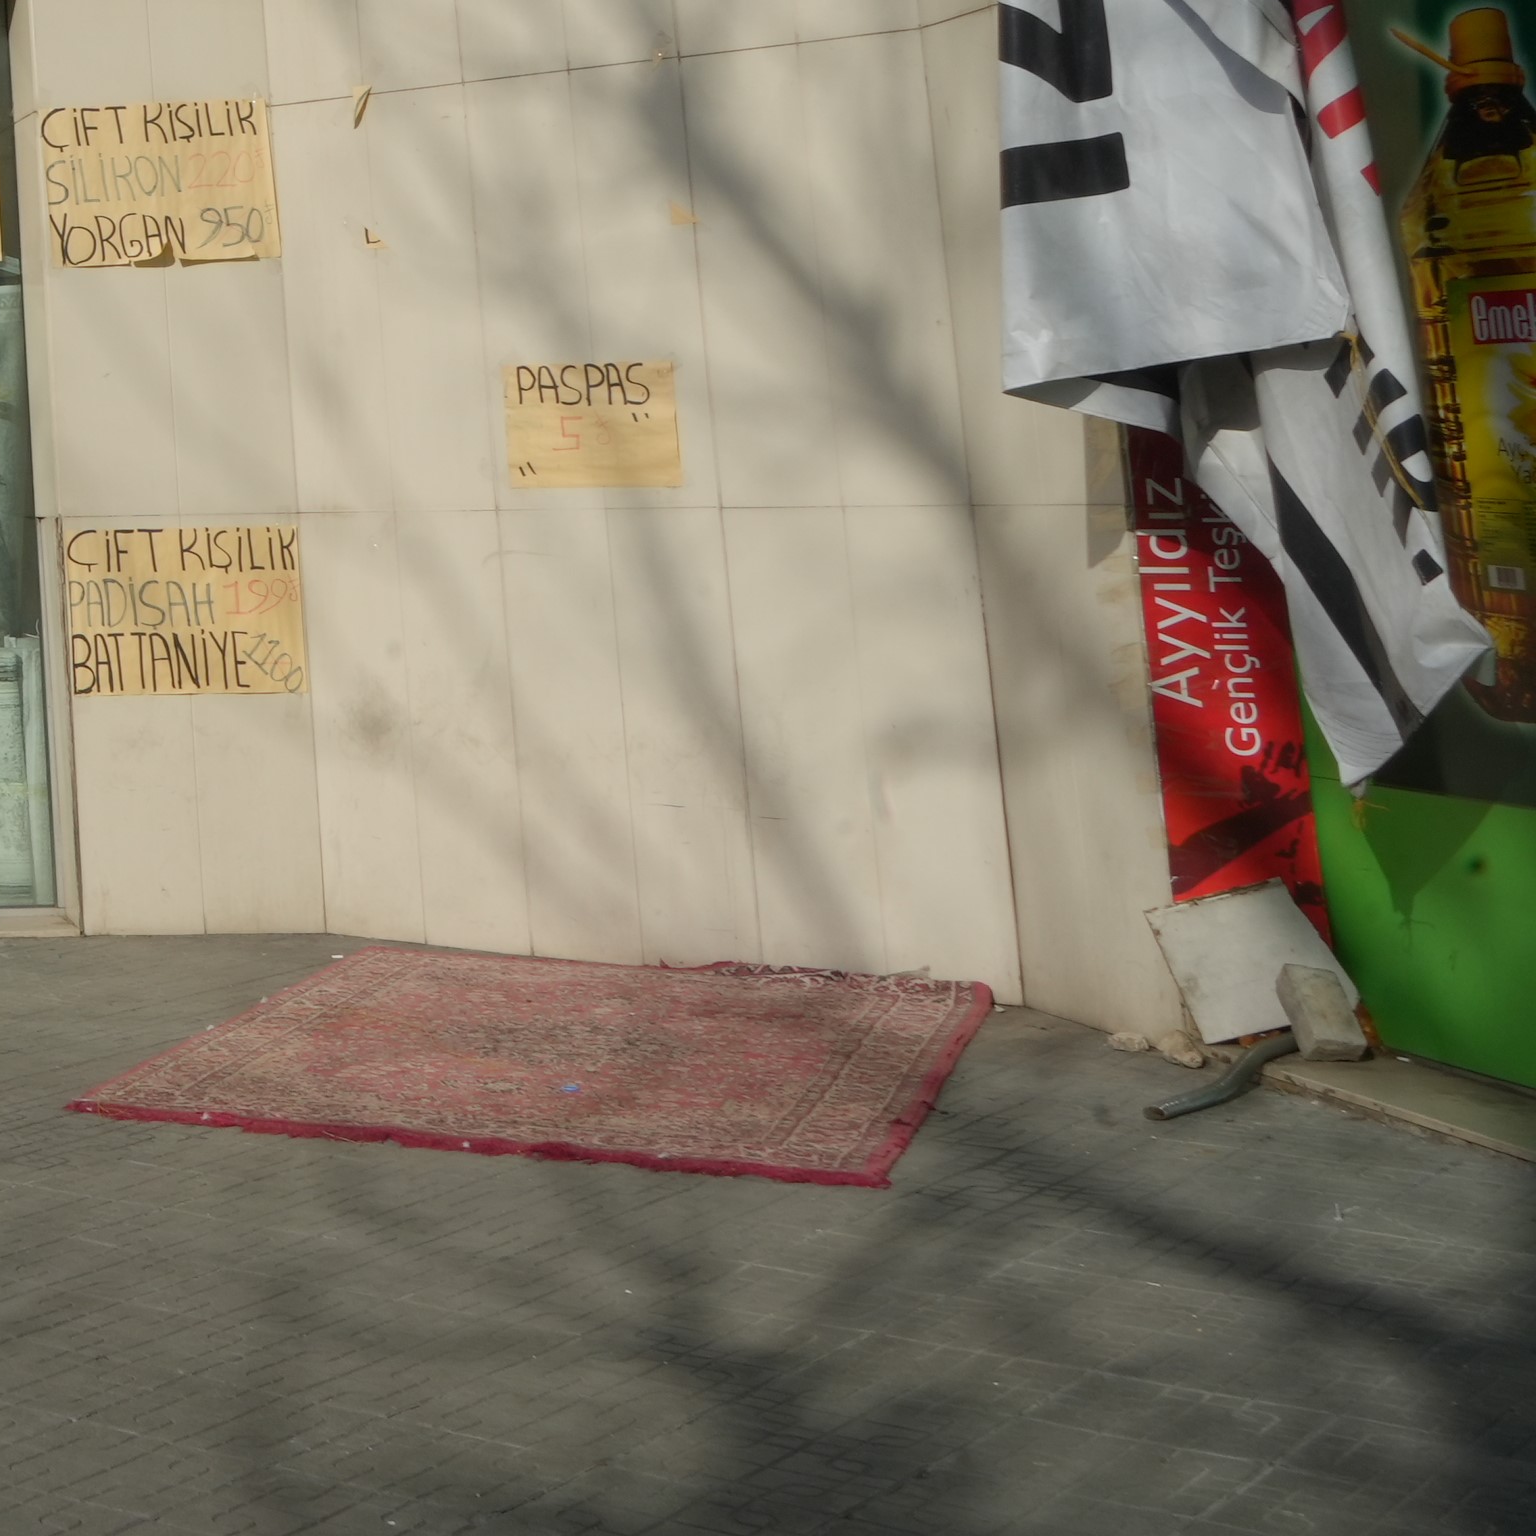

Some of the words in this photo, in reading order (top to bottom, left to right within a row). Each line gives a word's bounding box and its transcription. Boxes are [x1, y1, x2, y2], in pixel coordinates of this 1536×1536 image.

[40, 105, 127, 153] ÇİFT
[143, 100, 258, 145] KİŞİLİK
[45, 153, 182, 206] SİLİKON
[48, 212, 187, 268] YORGAN
[516, 362, 651, 407] PASPAS
[67, 528, 164, 573] ÇİFT
[178, 526, 296, 575] KİŞİLİK
[68, 577, 215, 630] PADİŞAH
[1138, 477, 1210, 708] Ayyıldız
[71, 628, 251, 695] BATTANİYE
[242, 632, 305, 694] 1100
[1213, 606, 1262, 756] Gençlik
